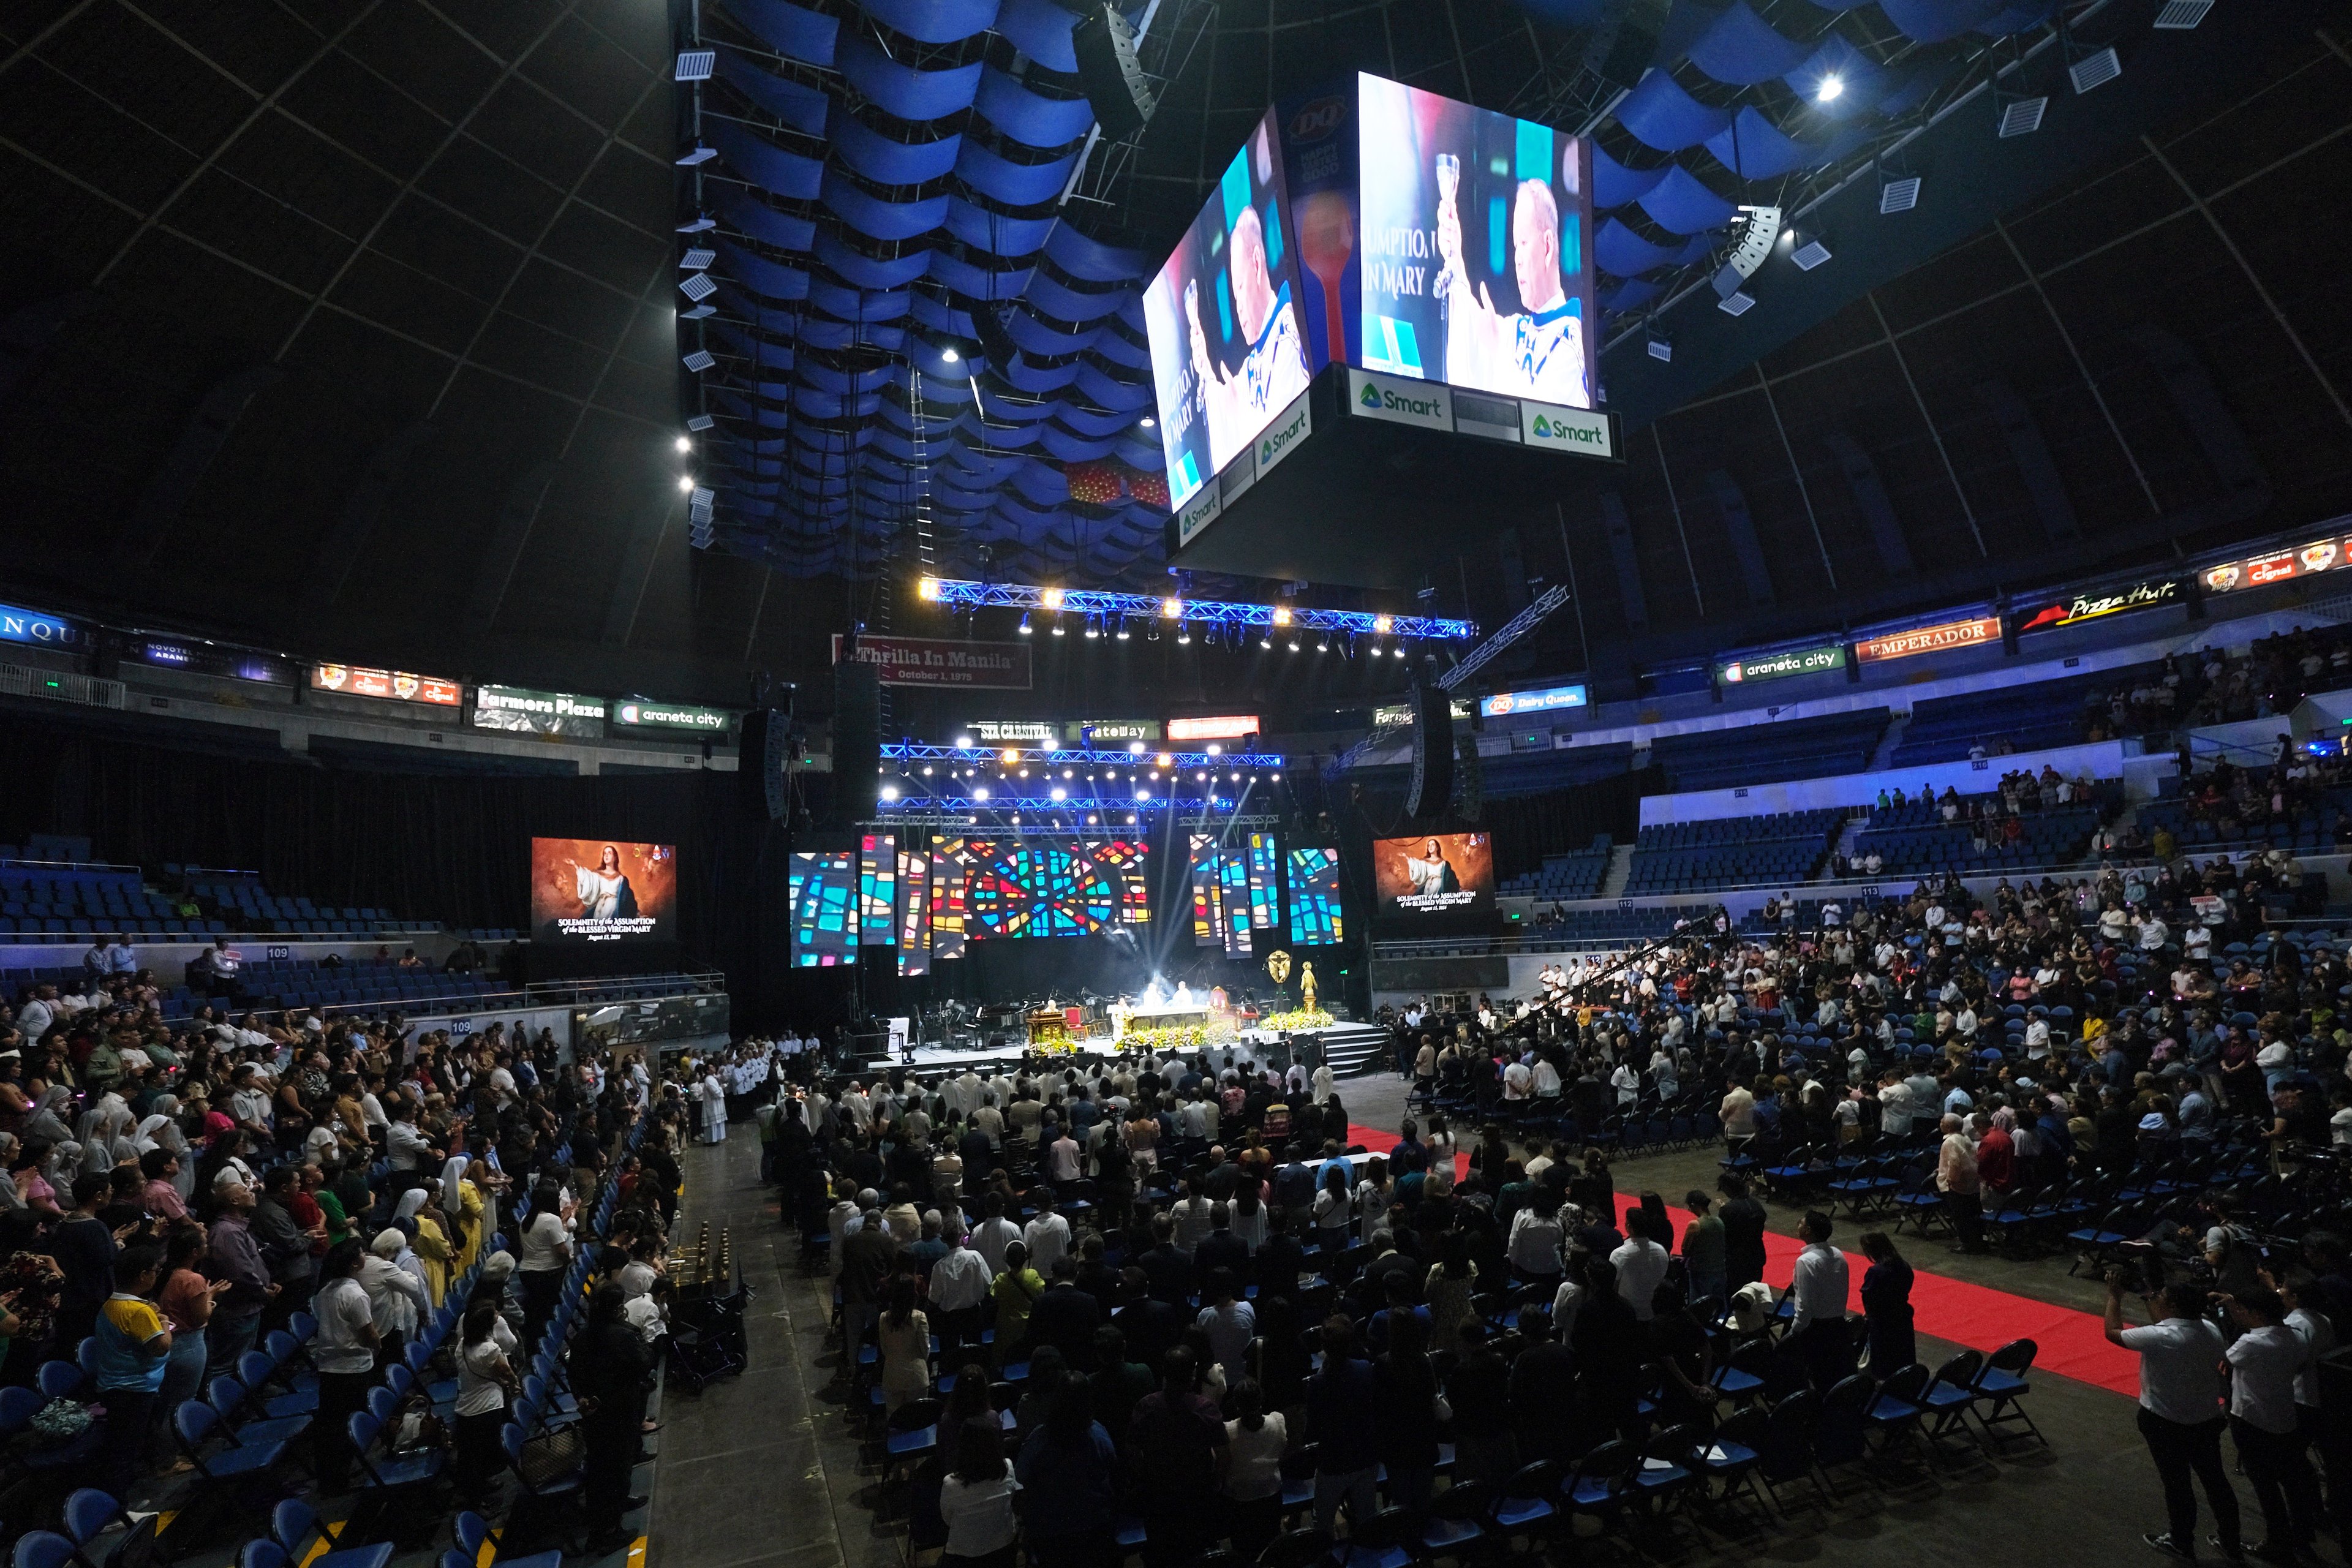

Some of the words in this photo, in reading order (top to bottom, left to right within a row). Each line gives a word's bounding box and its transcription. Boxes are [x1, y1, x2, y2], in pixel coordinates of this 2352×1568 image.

[1382, 260, 1425, 301] MARY
[1384, 390, 1441, 418] Smart
[1171, 396, 1193, 442] MARY
[1273, 410, 1306, 453] Smart
[1553, 420, 1603, 445] Smart
[1192, 494, 1216, 526] Smart
[2247, 556, 2280, 567] AVAILABLE
[2252, 565, 2292, 580] Cignal
[2068, 597, 2125, 619] Pizza
[1869, 625, 1986, 657] EMPERADOR
[147, 643, 192, 655] NOVOTEL
[858, 647, 921, 665] Thrilla
[924, 650, 944, 666] In
[948, 651, 1011, 669] Manila
[1747, 658, 1800, 675] araneta
[1805, 654, 1834, 666] city
[898, 669, 940, 680] October
[950, 673, 973, 681] 1975
[355, 679, 386, 693] Cignal
[425, 688, 453, 702] Cignal
[478, 690, 553, 712] Farmers
[556, 699, 605, 718] Plaza
[1493, 700, 1510, 710] DQ
[1518, 698, 1544, 707] Dairy
[643, 710, 693, 723] araneta
[696, 713, 722, 728] city
[1001, 725, 1052, 739] CARNIVAL
[1090, 725, 1146, 739] ateWay
[562, 926, 568, 935] of
[607, 924, 631, 933] VIRGIN
[631, 925, 651, 934] MARY
[614, 918, 656, 927] ASSUMPTION
[268, 948, 288, 957] 109
[453, 1022, 470, 1033] 109
